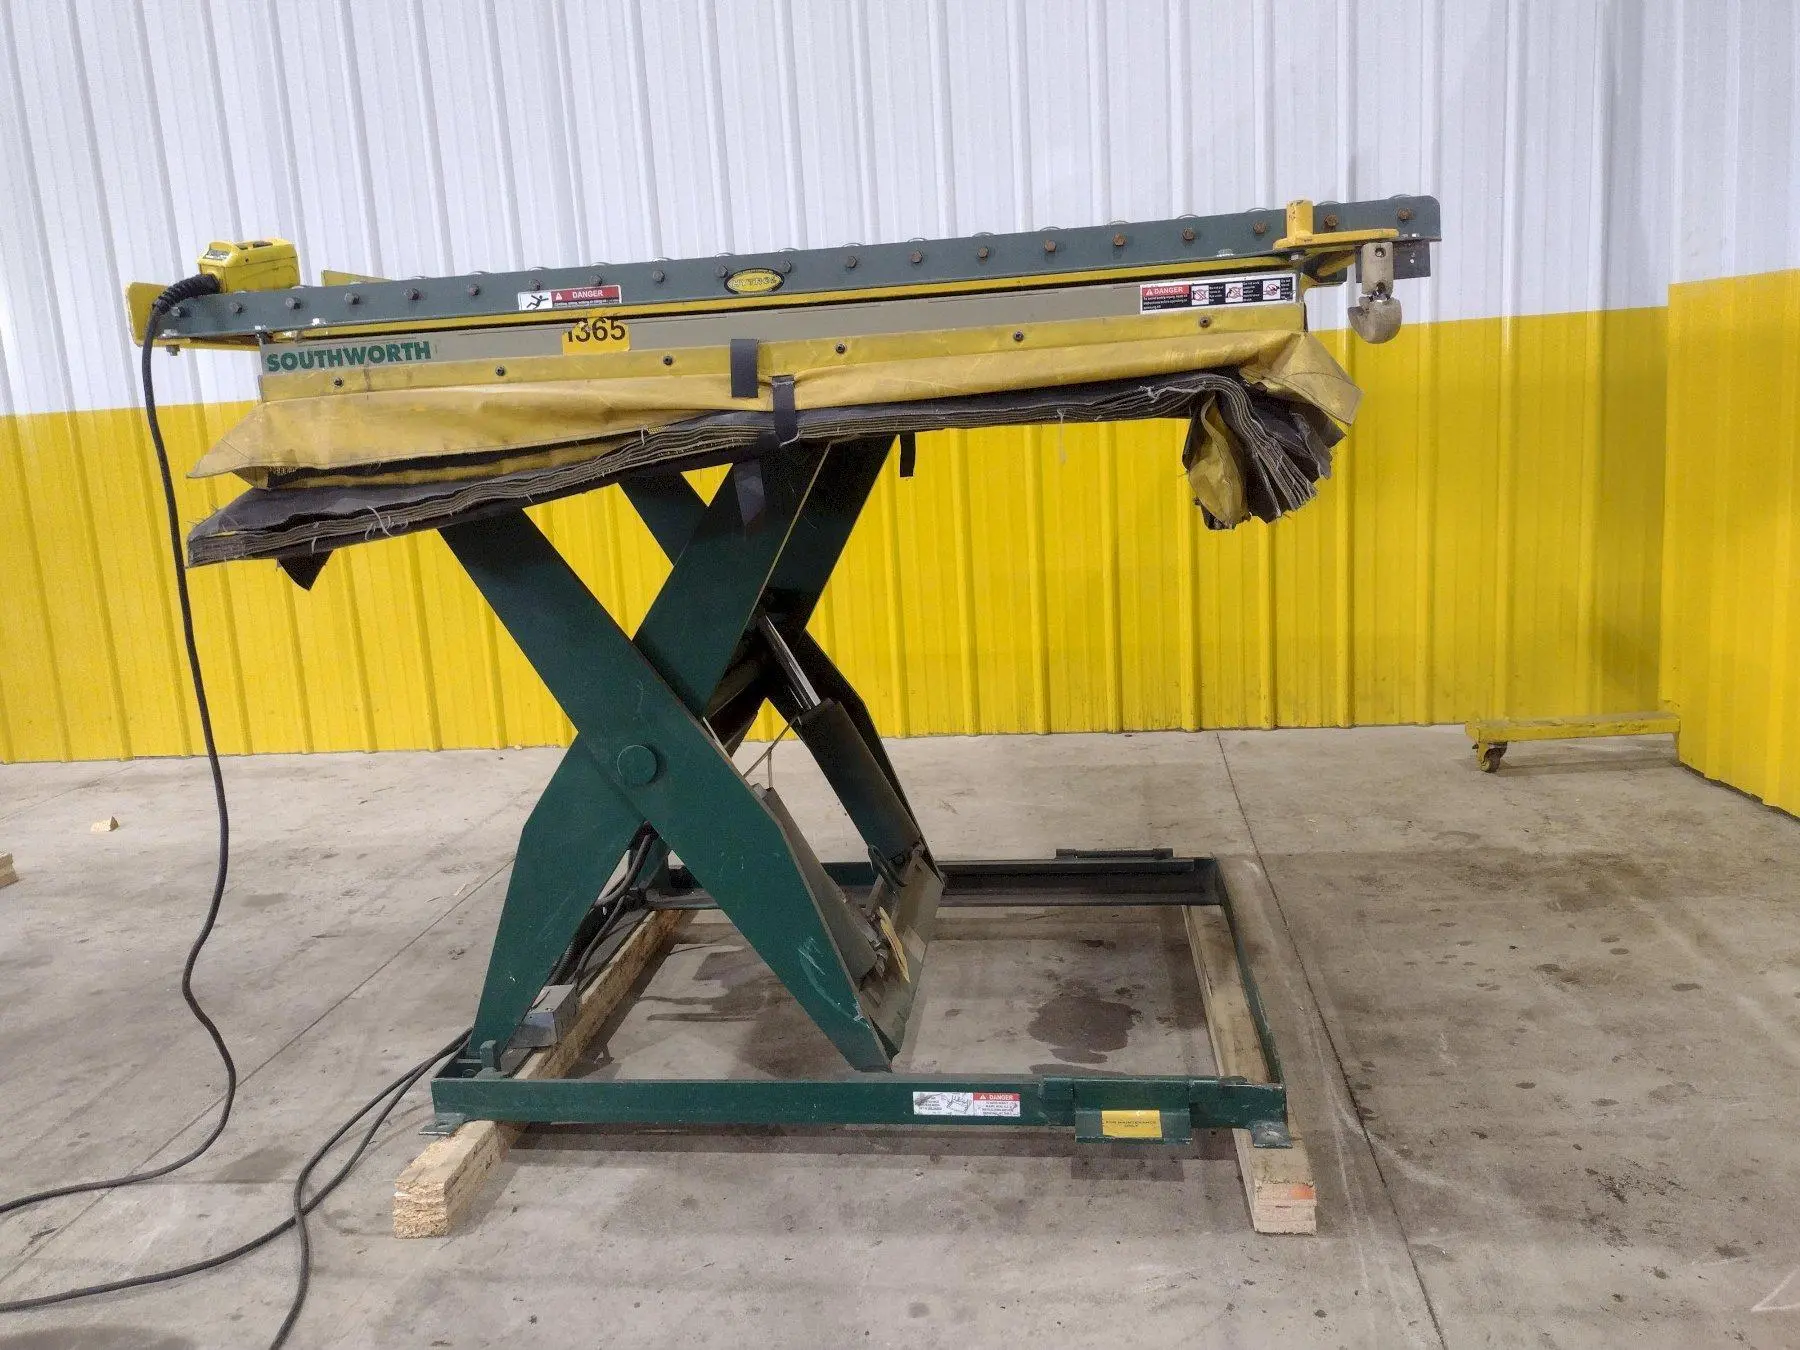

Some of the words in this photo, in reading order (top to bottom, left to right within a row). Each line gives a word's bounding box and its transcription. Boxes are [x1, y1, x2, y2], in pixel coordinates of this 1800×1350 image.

[572, 289, 604, 299] DANGER
[1154, 286, 1184, 295] DANGER
[266, 341, 432, 372] SOUTHWORTH
